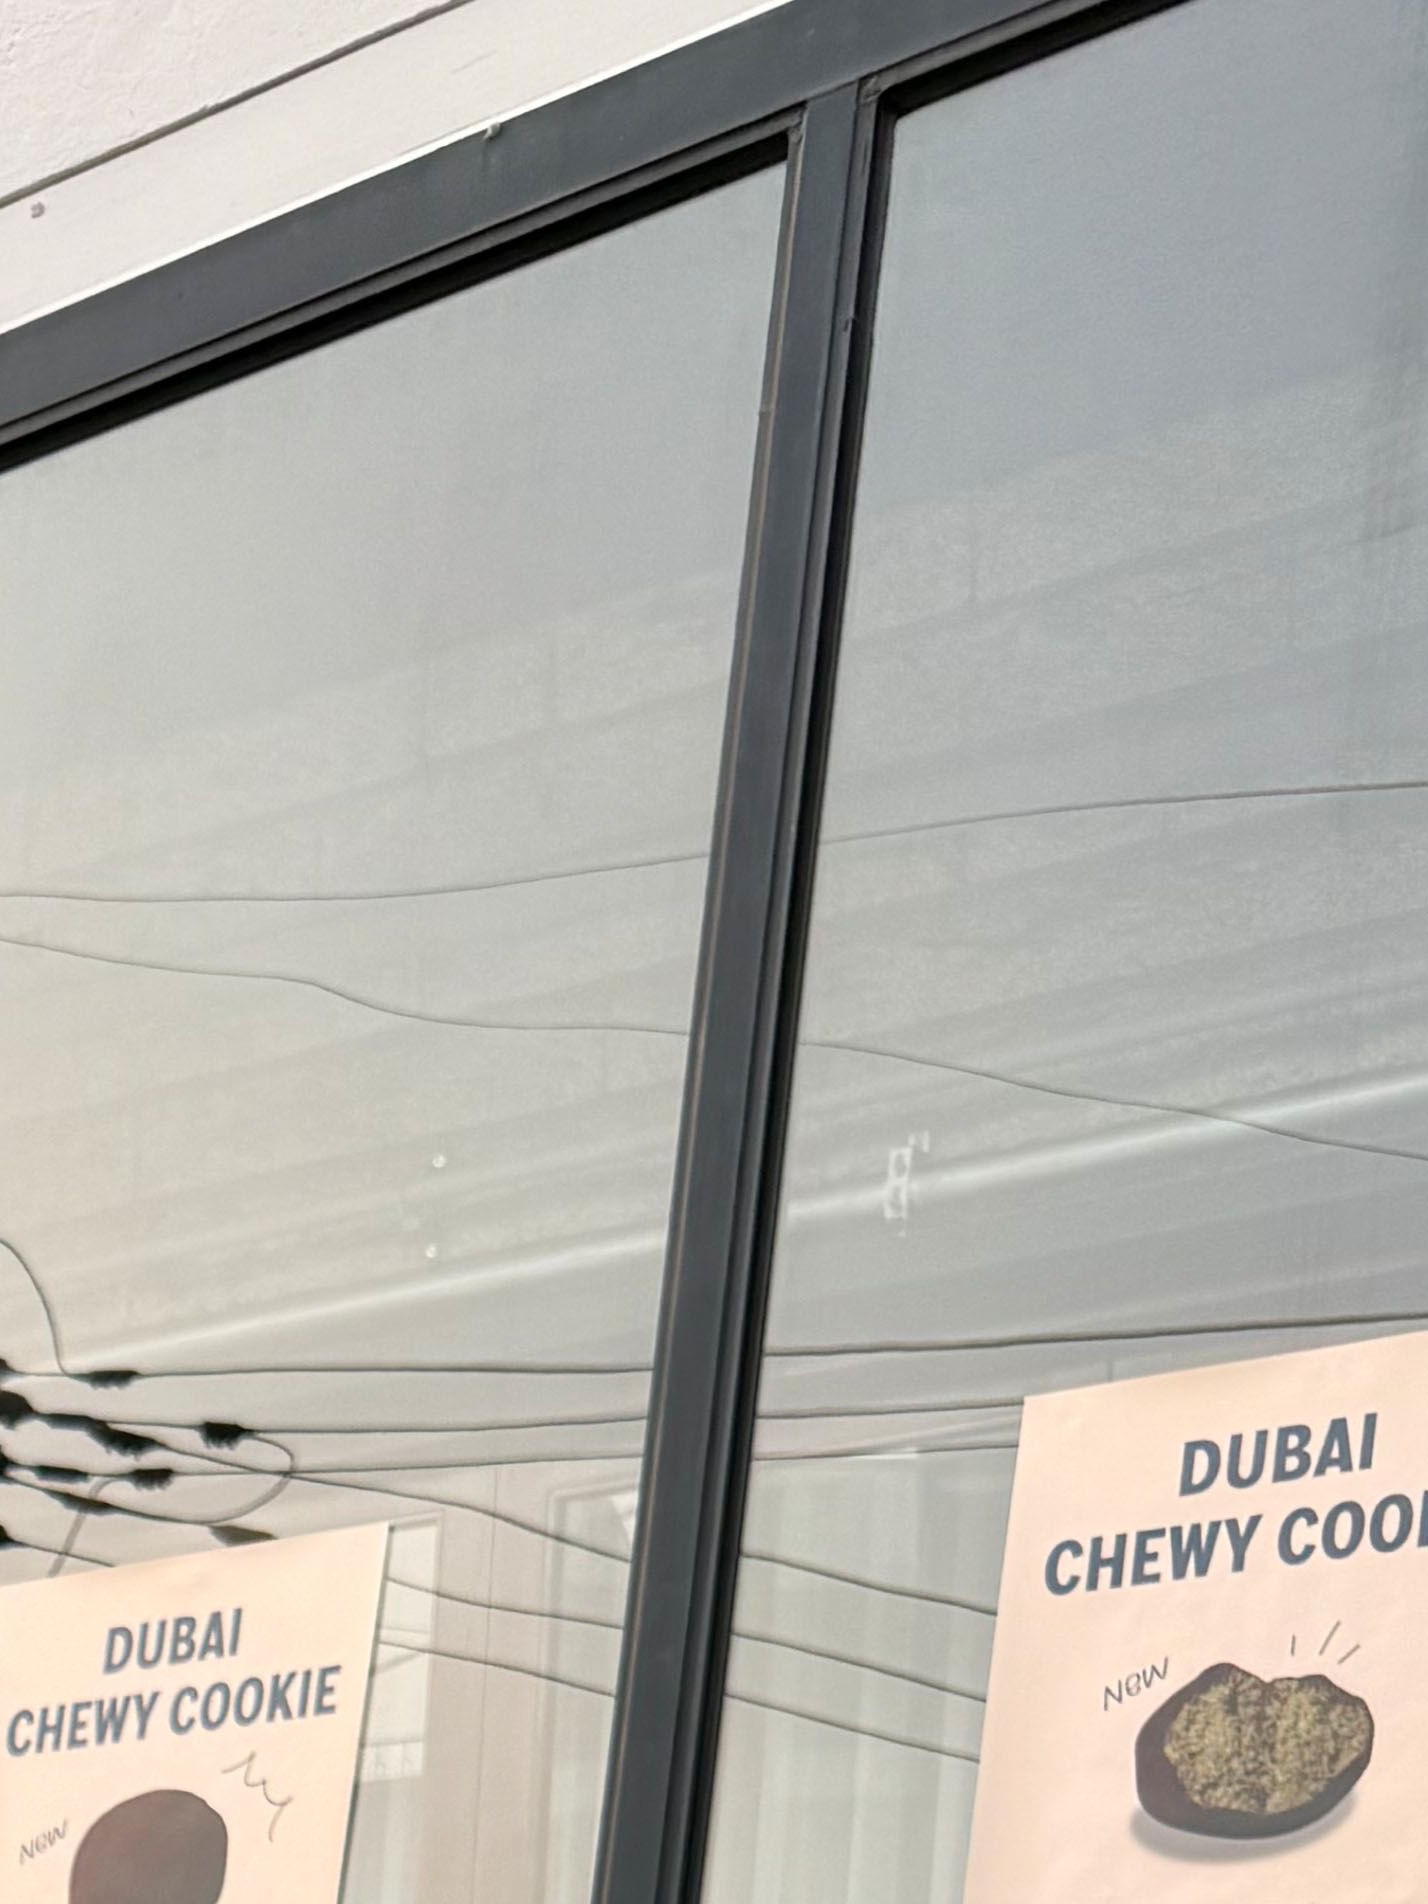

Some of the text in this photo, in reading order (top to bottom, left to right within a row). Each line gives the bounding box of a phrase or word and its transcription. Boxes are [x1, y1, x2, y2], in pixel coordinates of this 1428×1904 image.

[1178, 1412, 1379, 1498] DUBAI
[1044, 1513, 1264, 1597] CHEWY
[102, 1607, 243, 1676] DUBAI
[6, 1664, 343, 1758] CHEWY COOKIE
